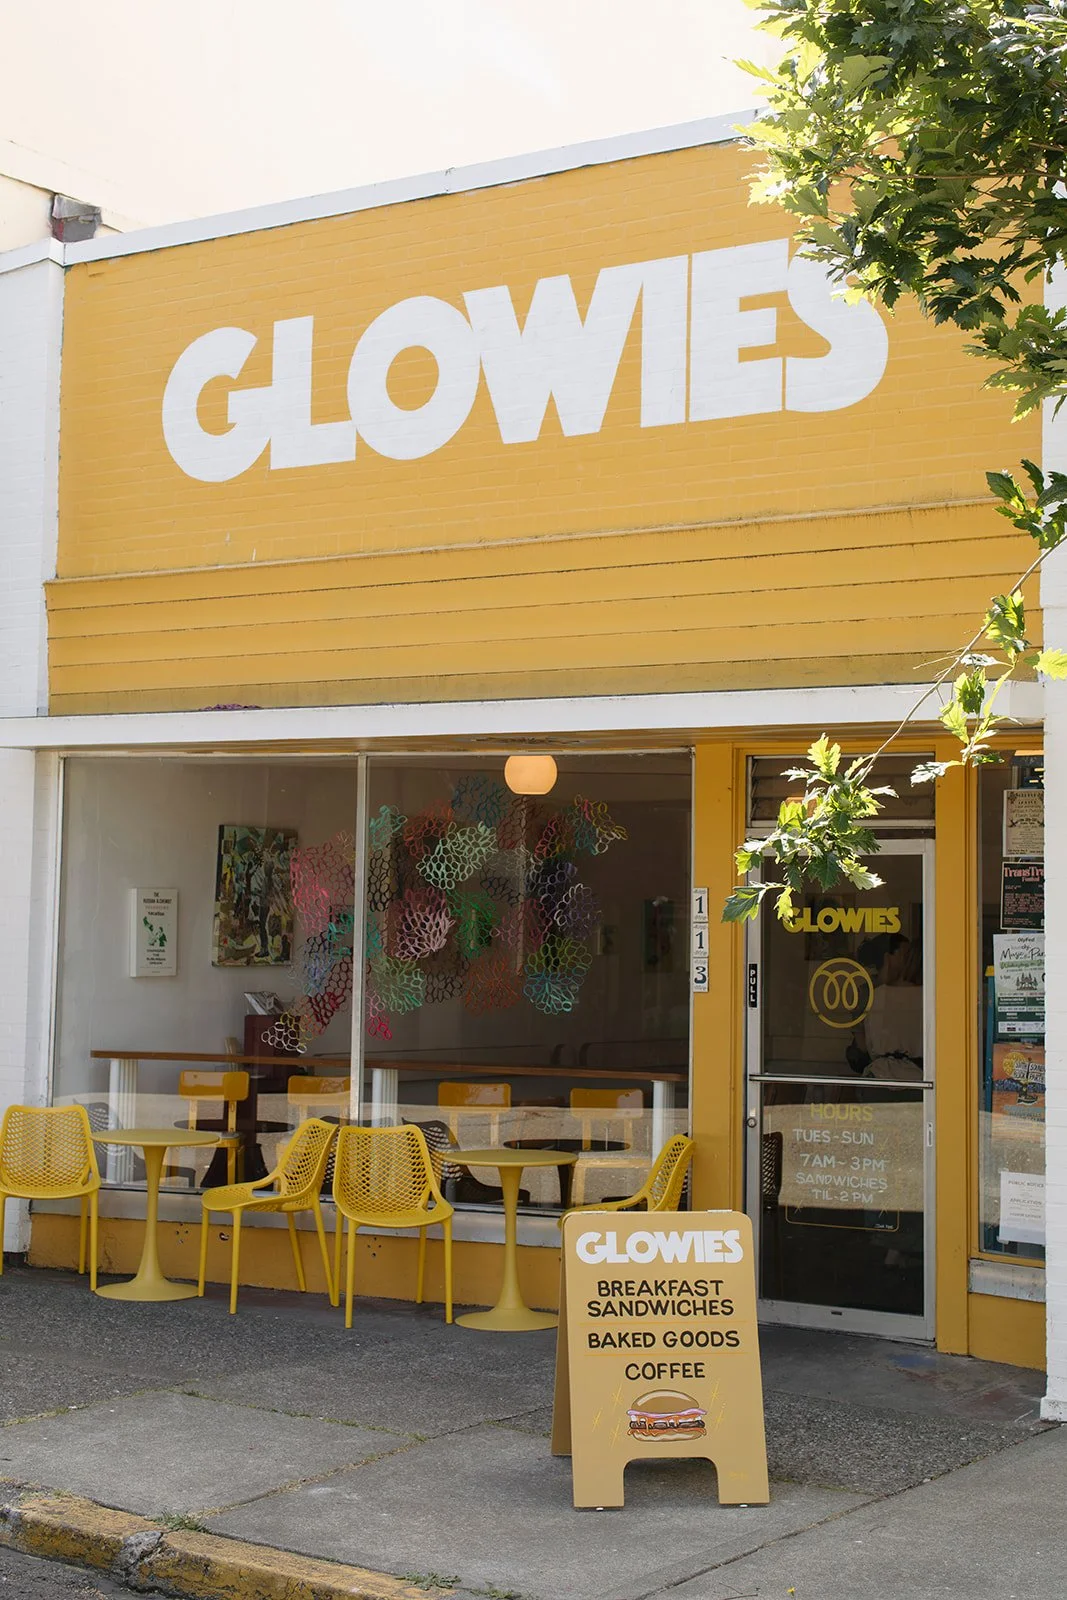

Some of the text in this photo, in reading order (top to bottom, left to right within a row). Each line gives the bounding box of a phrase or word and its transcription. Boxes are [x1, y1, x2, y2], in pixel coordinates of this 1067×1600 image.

[162, 238, 889, 483] GLOWIES
[782, 907, 902, 933] GLOWIES
[749, 969, 757, 1002] PULL
[809, 1103, 874, 1121] HOURS
[796, 1172, 888, 1190] SANDWICHES
[575, 1230, 744, 1264] GLOWIES
[597, 1280, 724, 1297] BREAKFAST
[587, 1299, 734, 1317] SANDWICHES
[588, 1330, 740, 1348] BAKED GOODS
[625, 1362, 705, 1380] COFFEE
